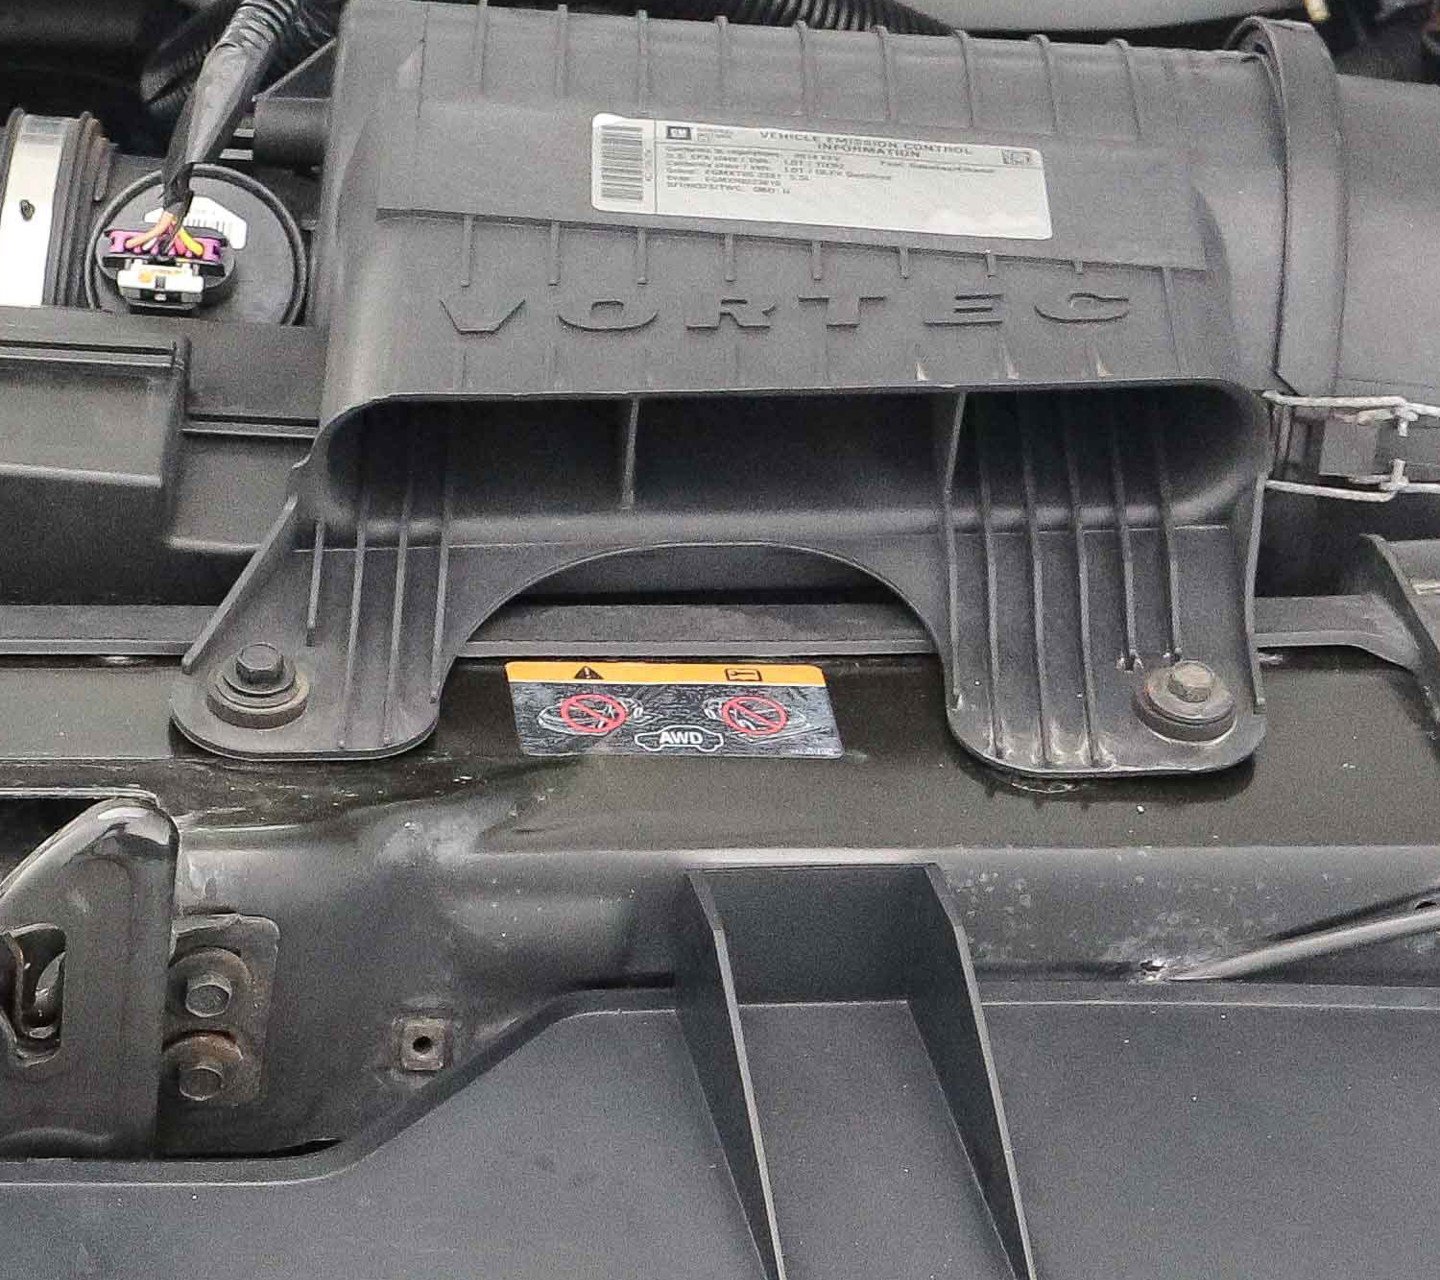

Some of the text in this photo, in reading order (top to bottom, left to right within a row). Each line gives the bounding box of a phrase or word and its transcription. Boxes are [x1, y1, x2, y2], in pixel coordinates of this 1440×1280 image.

[818, 142, 921, 158] INFORMATION
[826, 135, 898, 149] EMISSION
[903, 141, 972, 156] CONTROL
[438, 291, 1130, 335] VORTEC
[659, 731, 704, 745] AWD
